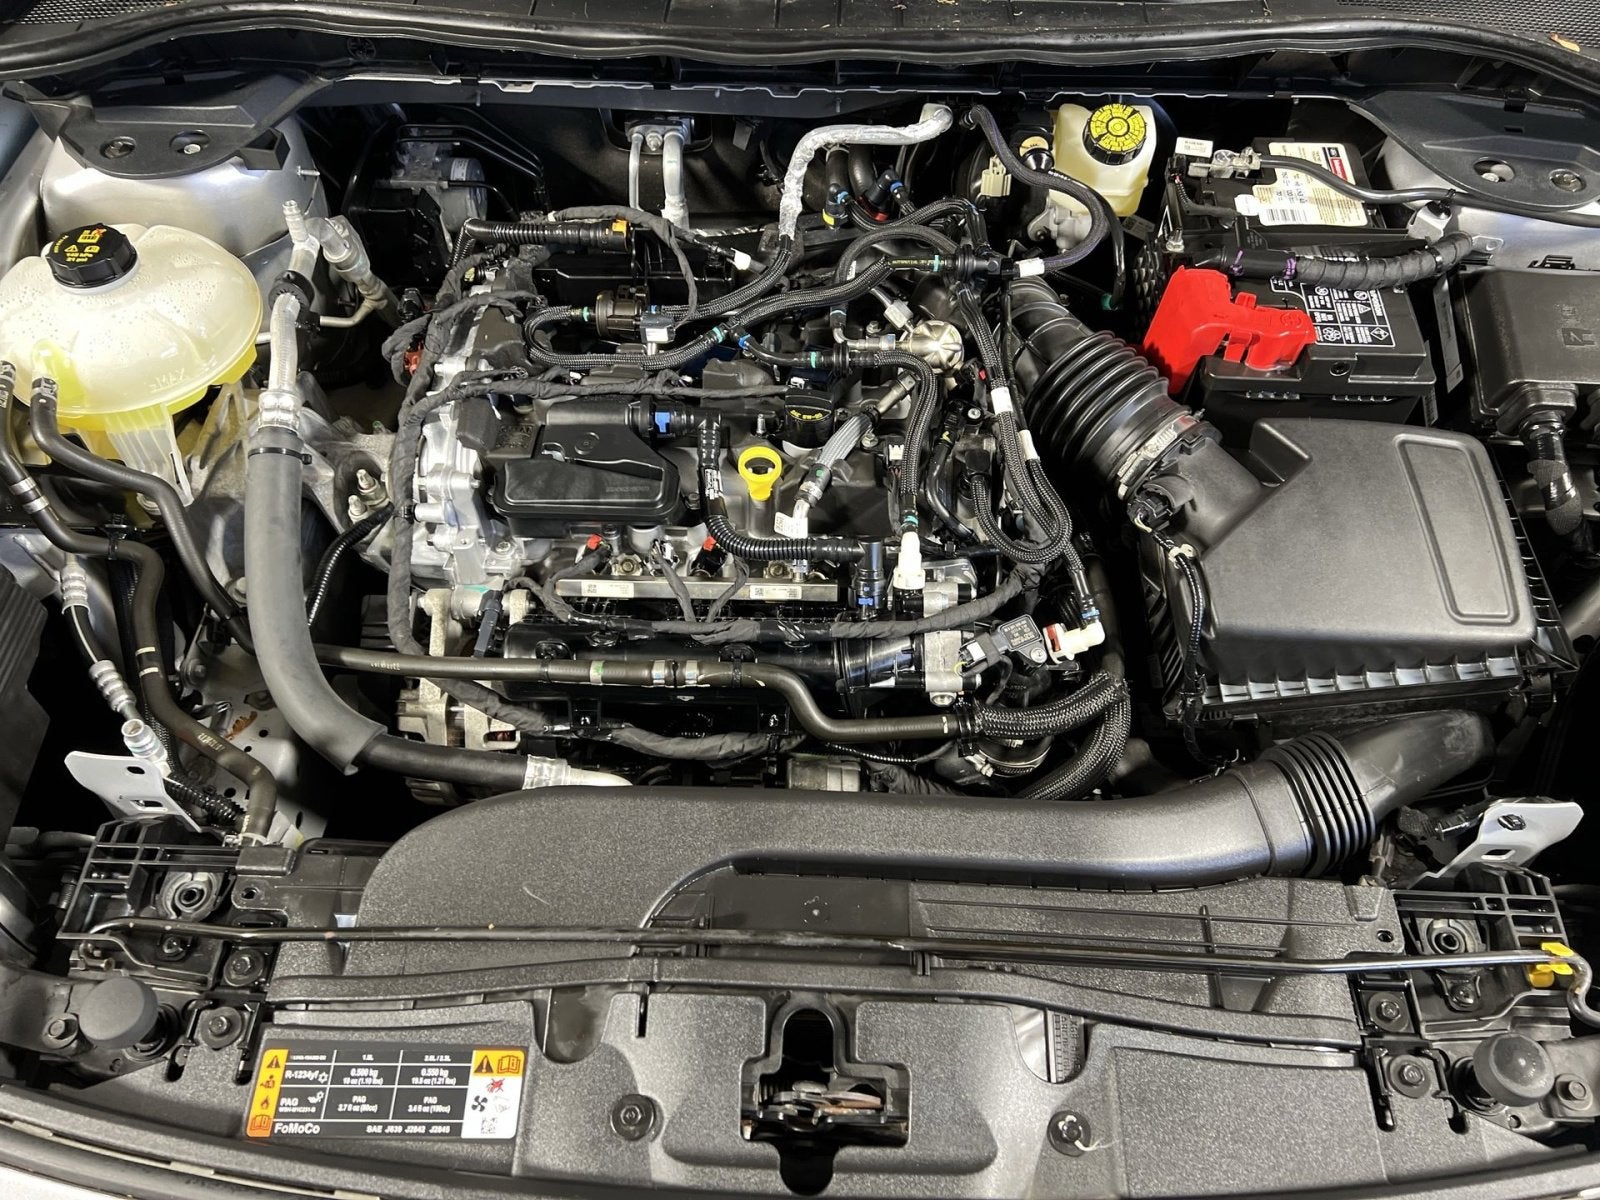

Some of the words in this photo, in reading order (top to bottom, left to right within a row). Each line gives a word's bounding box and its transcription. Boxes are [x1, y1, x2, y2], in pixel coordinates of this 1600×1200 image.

[285, 1070, 319, 1080] R-1234yf
[369, 1068, 379, 1078] kg
[439, 1068, 449, 1078] kg
[274, 1123, 320, 1134] FoMoCo
[366, 1125, 383, 1133] SAE
